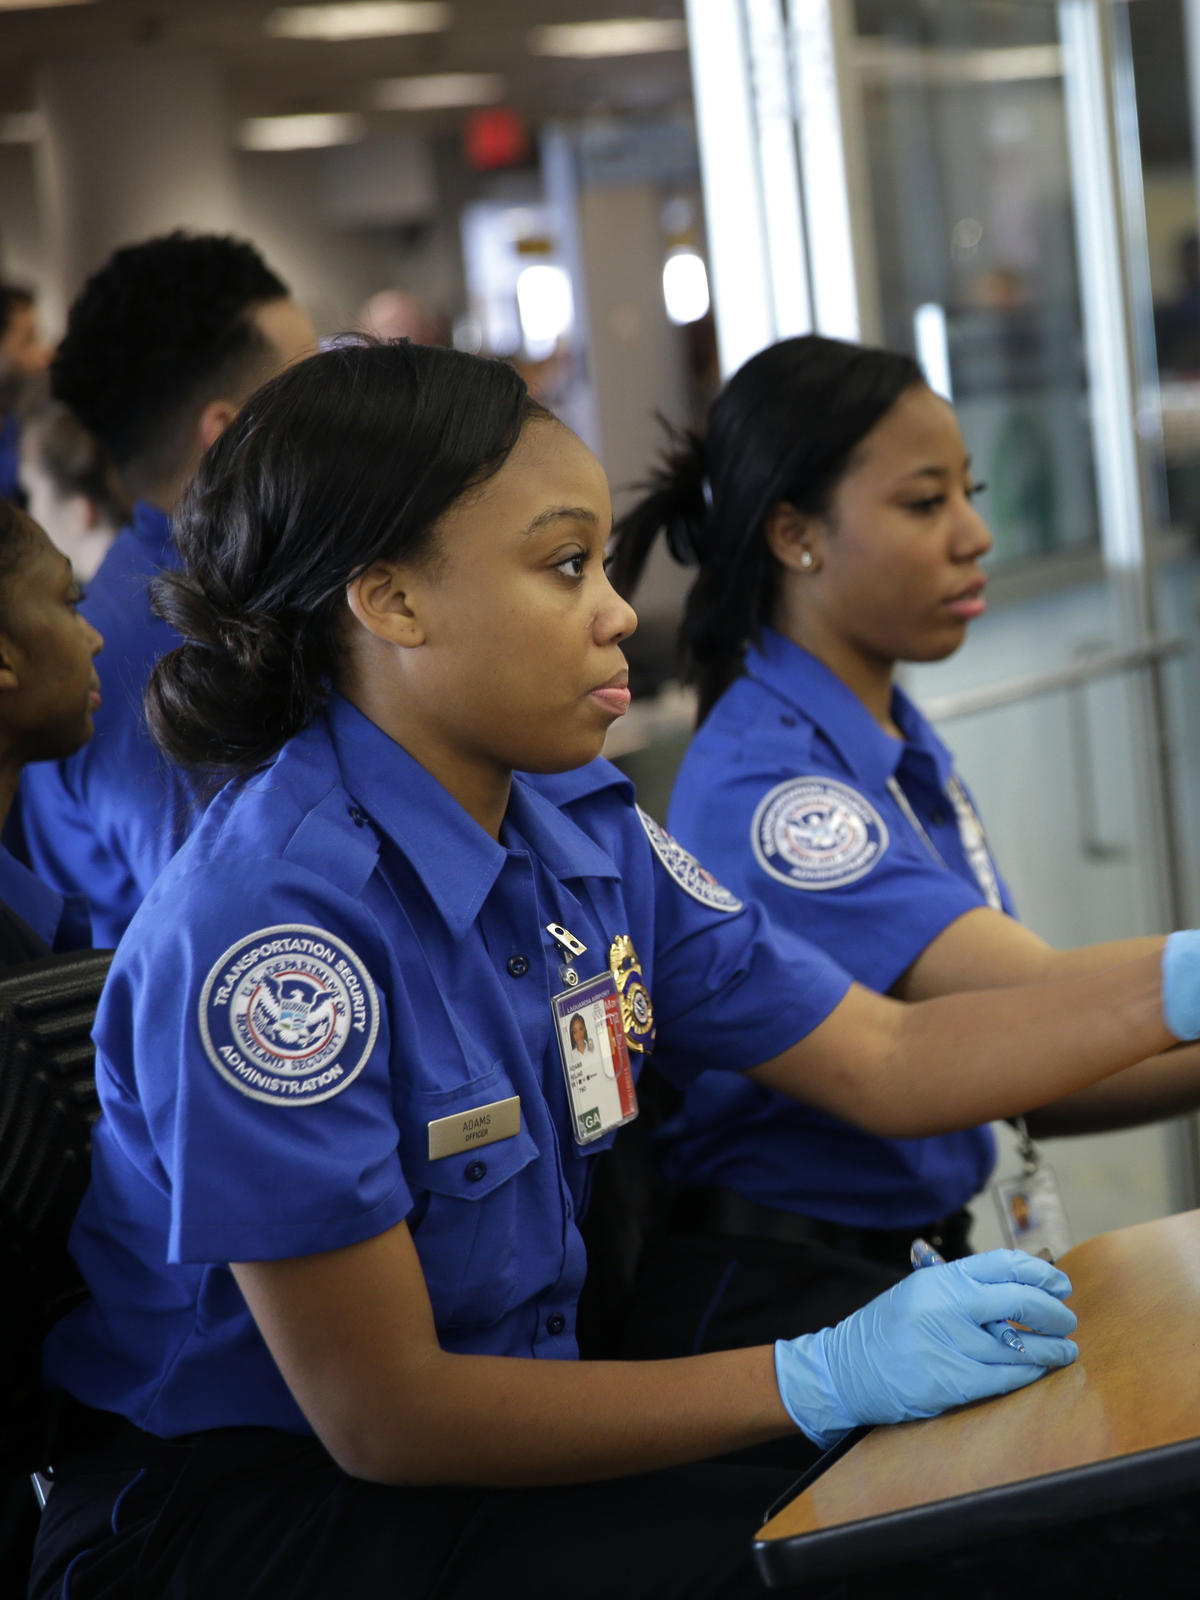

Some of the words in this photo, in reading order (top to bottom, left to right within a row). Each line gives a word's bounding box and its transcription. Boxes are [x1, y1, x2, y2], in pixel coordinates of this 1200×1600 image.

[213, 938, 336, 1006] TRANSPORTATION
[335, 959, 367, 1032] SECURITY
[236, 1013, 286, 1069] HOMELAND
[290, 1032, 342, 1071] SECURITY
[219, 1045, 344, 1094] ADMINISTRATION
[463, 1114, 492, 1133] ADAMS
[465, 1129, 489, 1142] OFFICER
